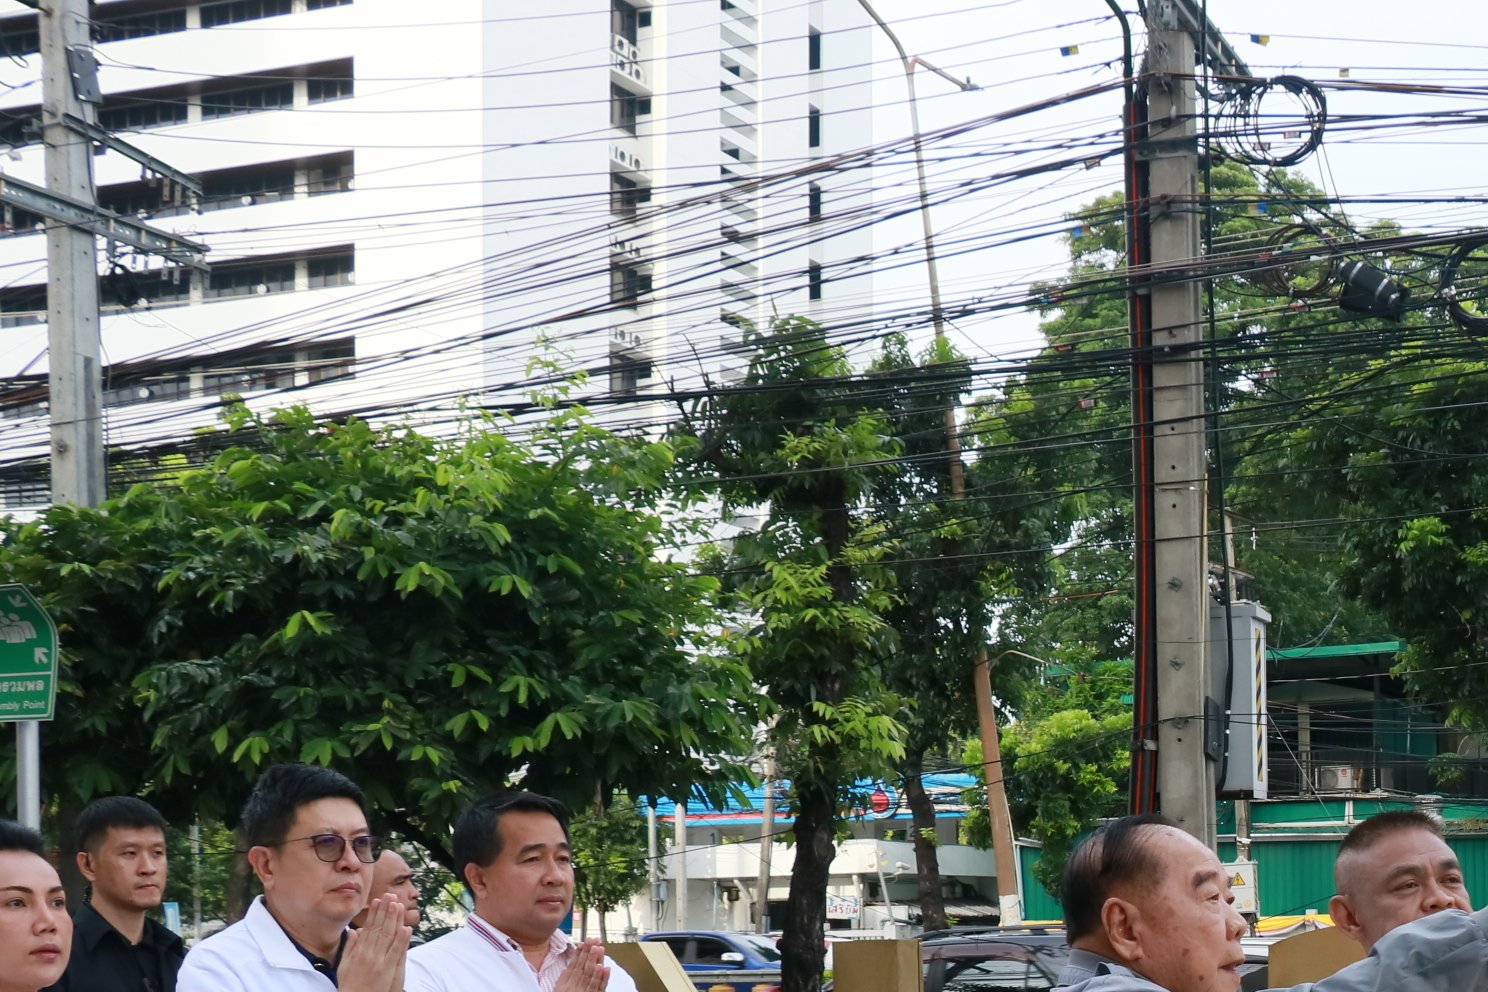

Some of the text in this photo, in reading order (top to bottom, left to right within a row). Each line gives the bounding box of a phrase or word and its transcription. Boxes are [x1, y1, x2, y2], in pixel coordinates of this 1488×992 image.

[0, 680, 44, 692] รวมพล
[0, 700, 45, 711] mbly Point
